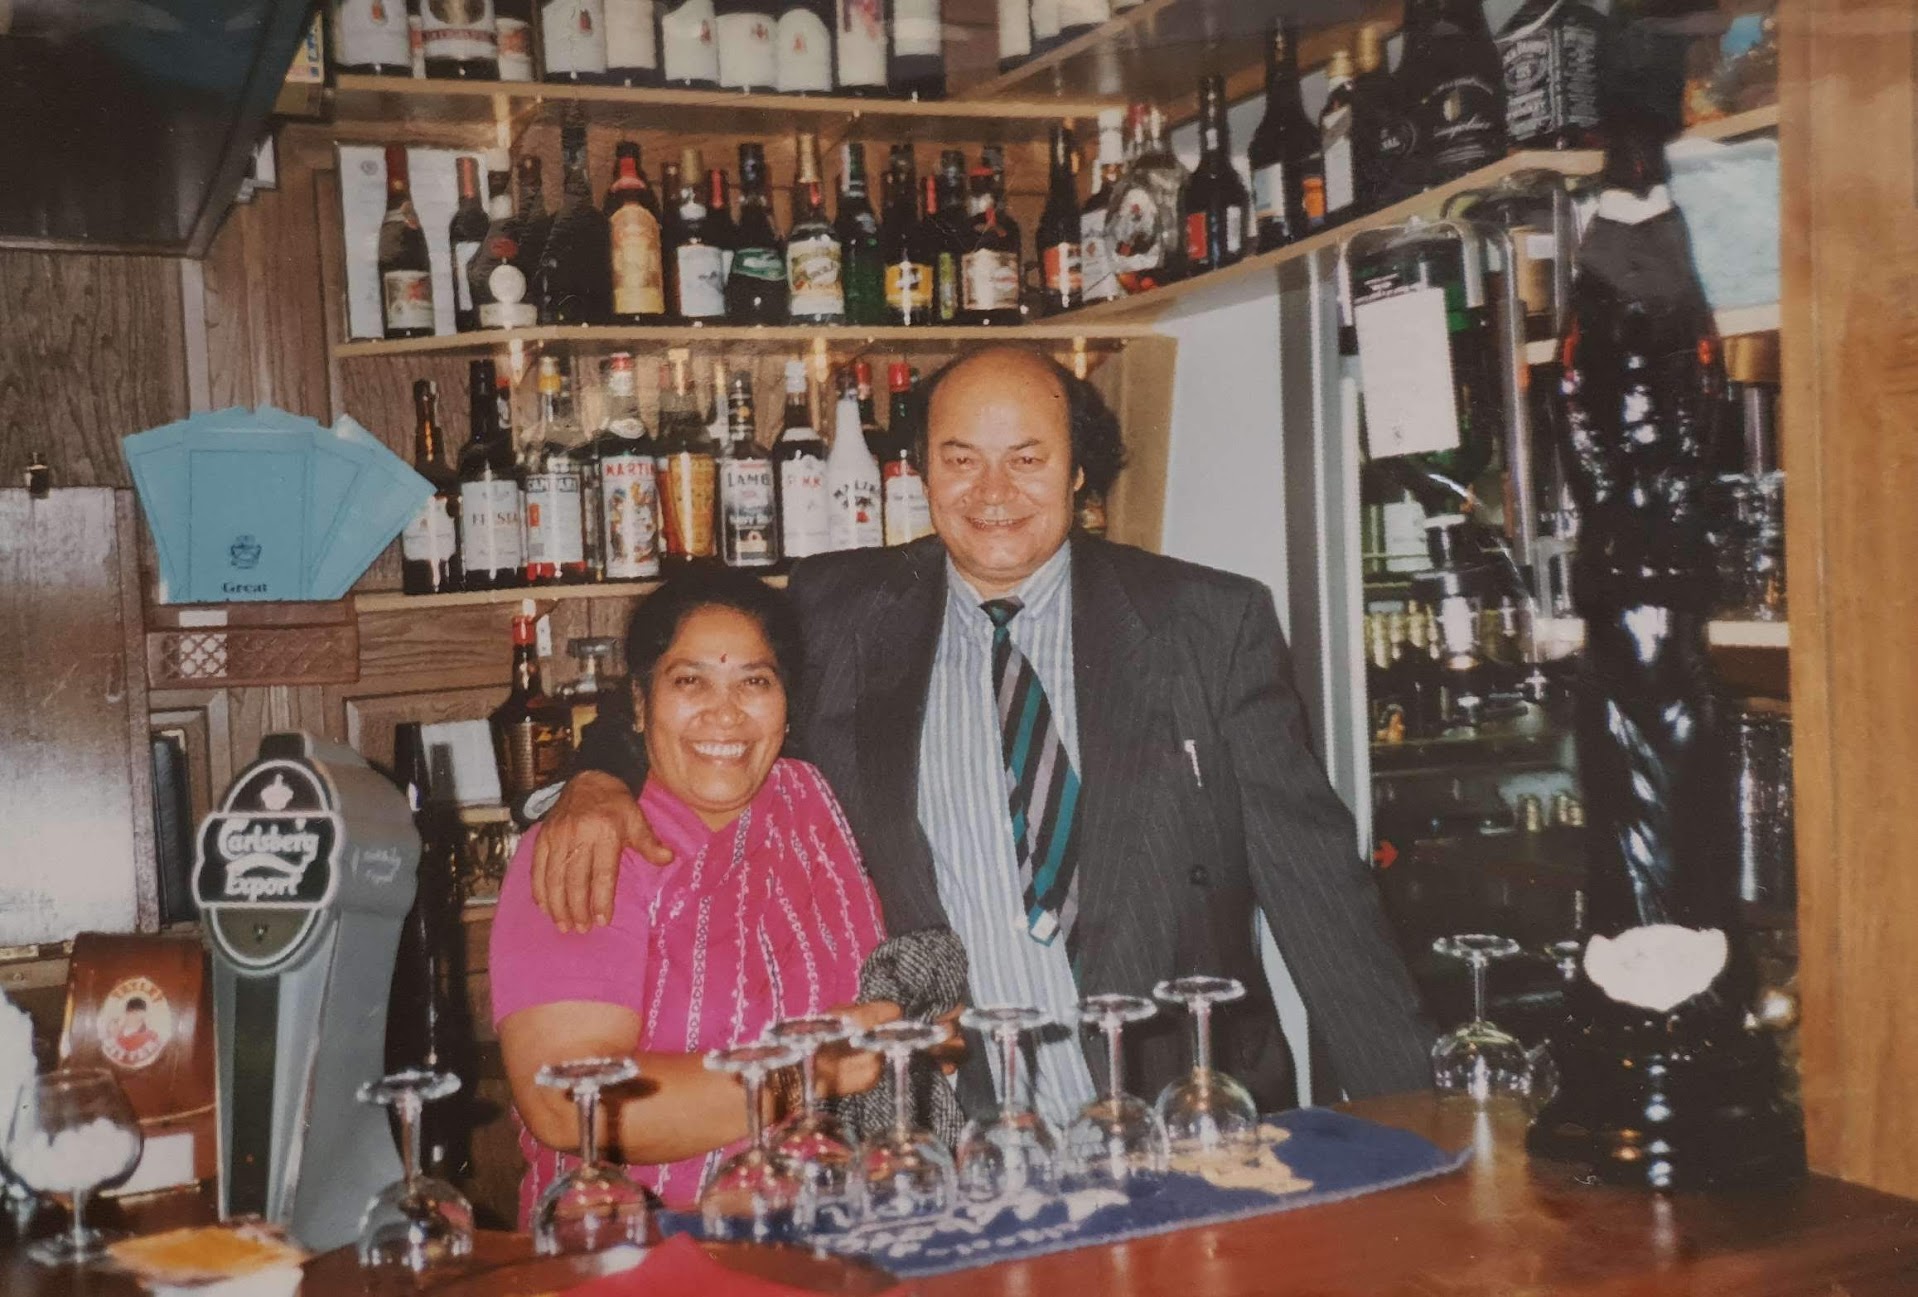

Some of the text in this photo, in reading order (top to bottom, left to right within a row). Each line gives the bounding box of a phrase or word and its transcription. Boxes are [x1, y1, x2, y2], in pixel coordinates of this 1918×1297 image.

[222, 582, 268, 593] Great
[218, 818, 319, 866] Carlsberg
[225, 868, 301, 901] Export
